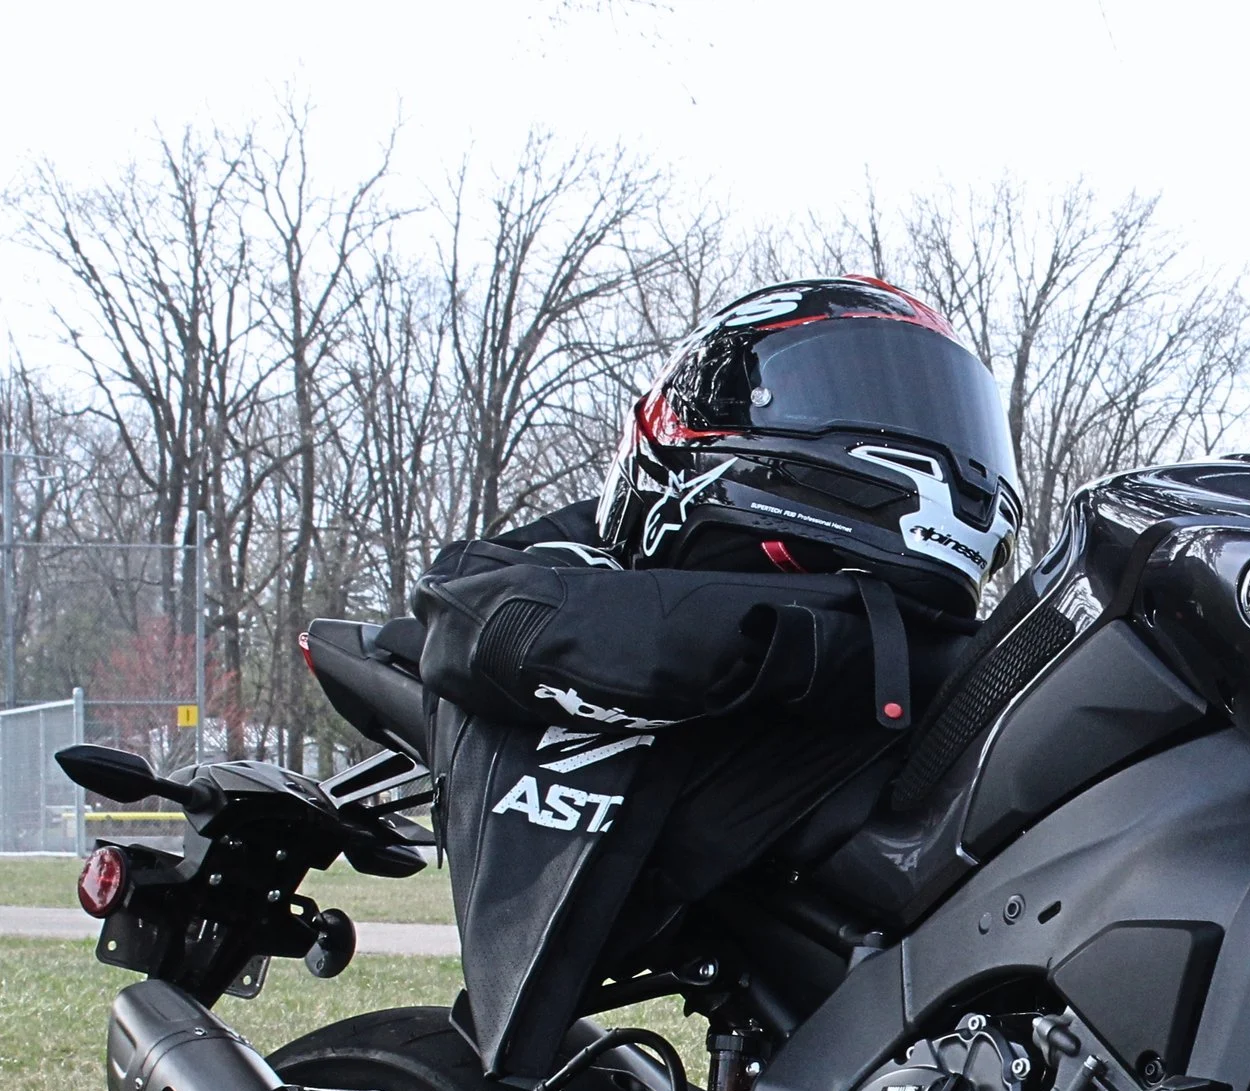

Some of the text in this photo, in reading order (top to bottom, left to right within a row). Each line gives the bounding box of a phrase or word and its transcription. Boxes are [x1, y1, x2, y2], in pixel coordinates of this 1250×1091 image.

[750, 502, 782, 515] SUPERTECH
[797, 513, 831, 527] Professional
[831, 522, 853, 533] Helmet
[909, 525, 988, 570] alpinestars
[534, 683, 678, 730] alpine
[491, 774, 625, 833] AST
